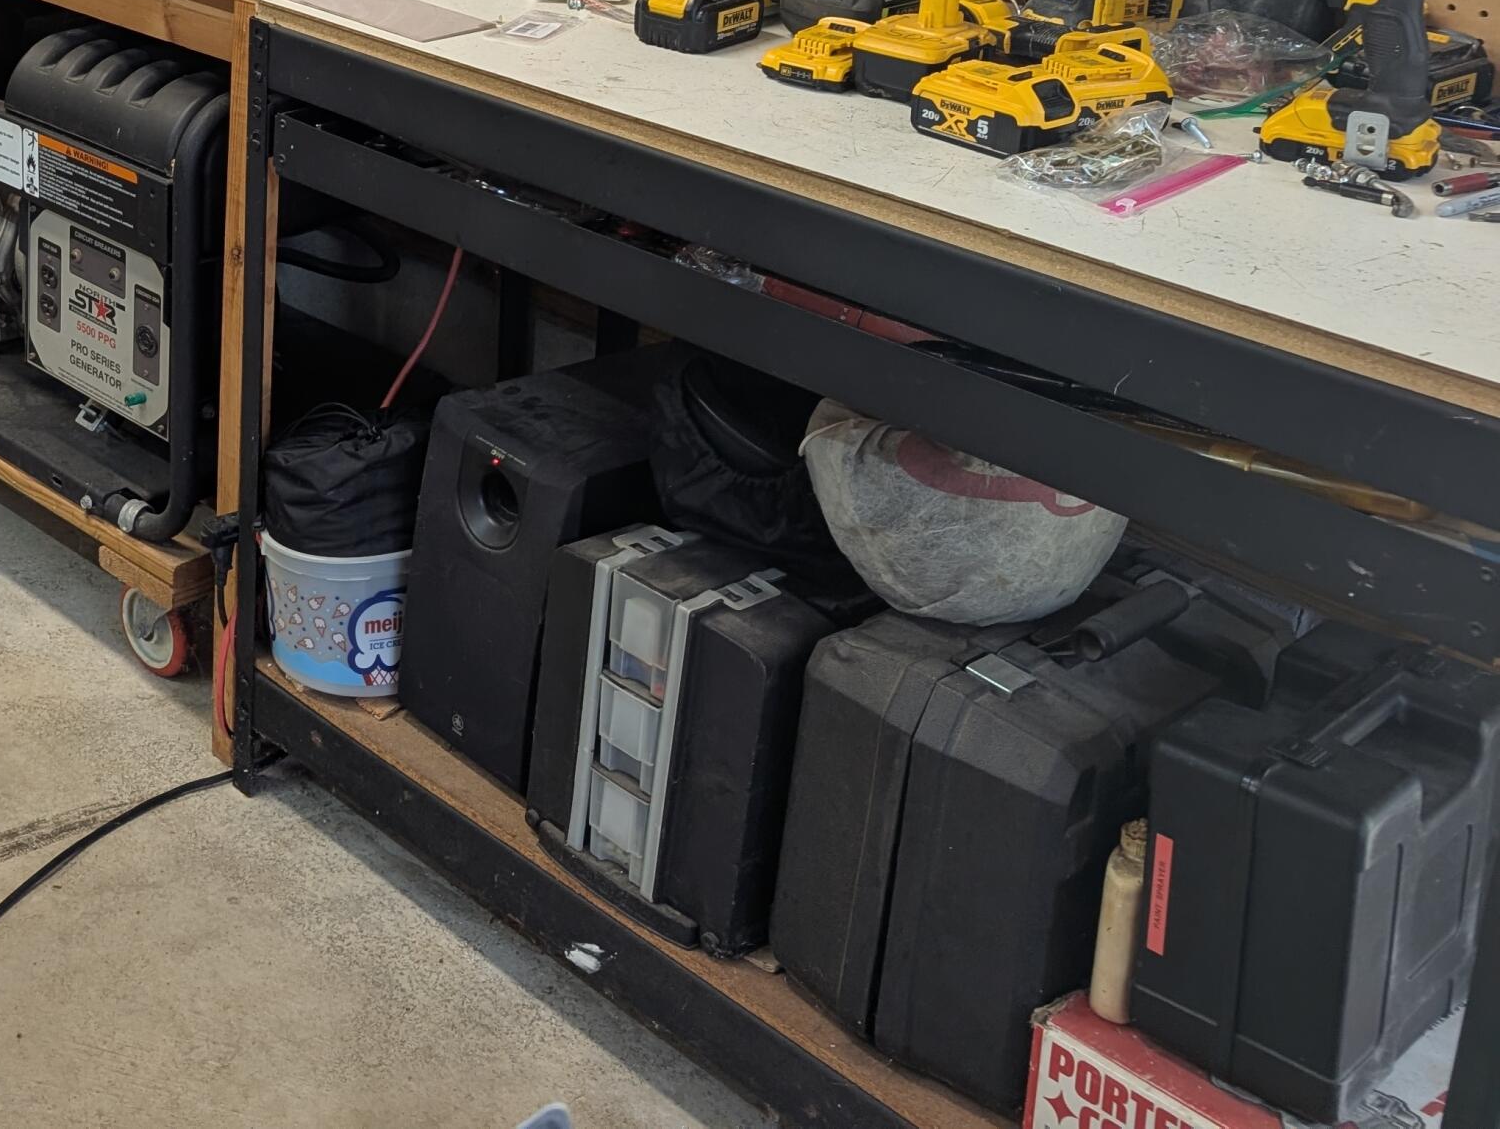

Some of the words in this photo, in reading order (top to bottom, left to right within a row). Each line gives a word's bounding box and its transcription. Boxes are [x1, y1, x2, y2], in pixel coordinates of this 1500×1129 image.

[723, 7, 754, 28] DEWALT
[1437, 79, 1470, 99] DEWALT
[922, 109, 940, 121] 20V
[940, 100, 971, 116] DEWALT
[1096, 99, 1125, 111] DEWALT
[931, 113, 977, 142] XR
[977, 120, 989, 135] 5
[74, 149, 109, 170] WARNING!
[74, 231, 93, 245] CIRCUIT
[94, 240, 121, 258] BREAKERS
[78, 283, 117, 307] NORTH
[76, 321, 96, 339] 5500
[98, 331, 116, 349] PPG
[71, 339, 87, 355] PRO
[90, 349, 121, 374] SERIES
[69, 354, 122, 391] GENERATOR
[365, 611, 403, 634] meij
[370, 642, 385, 650] ICE
[386, 638, 404, 648] CRE
[1155, 860, 1167, 901] SPRAYER
[1153, 903, 1162, 930] PAINT
[1048, 1041, 1194, 1129] PORTE
